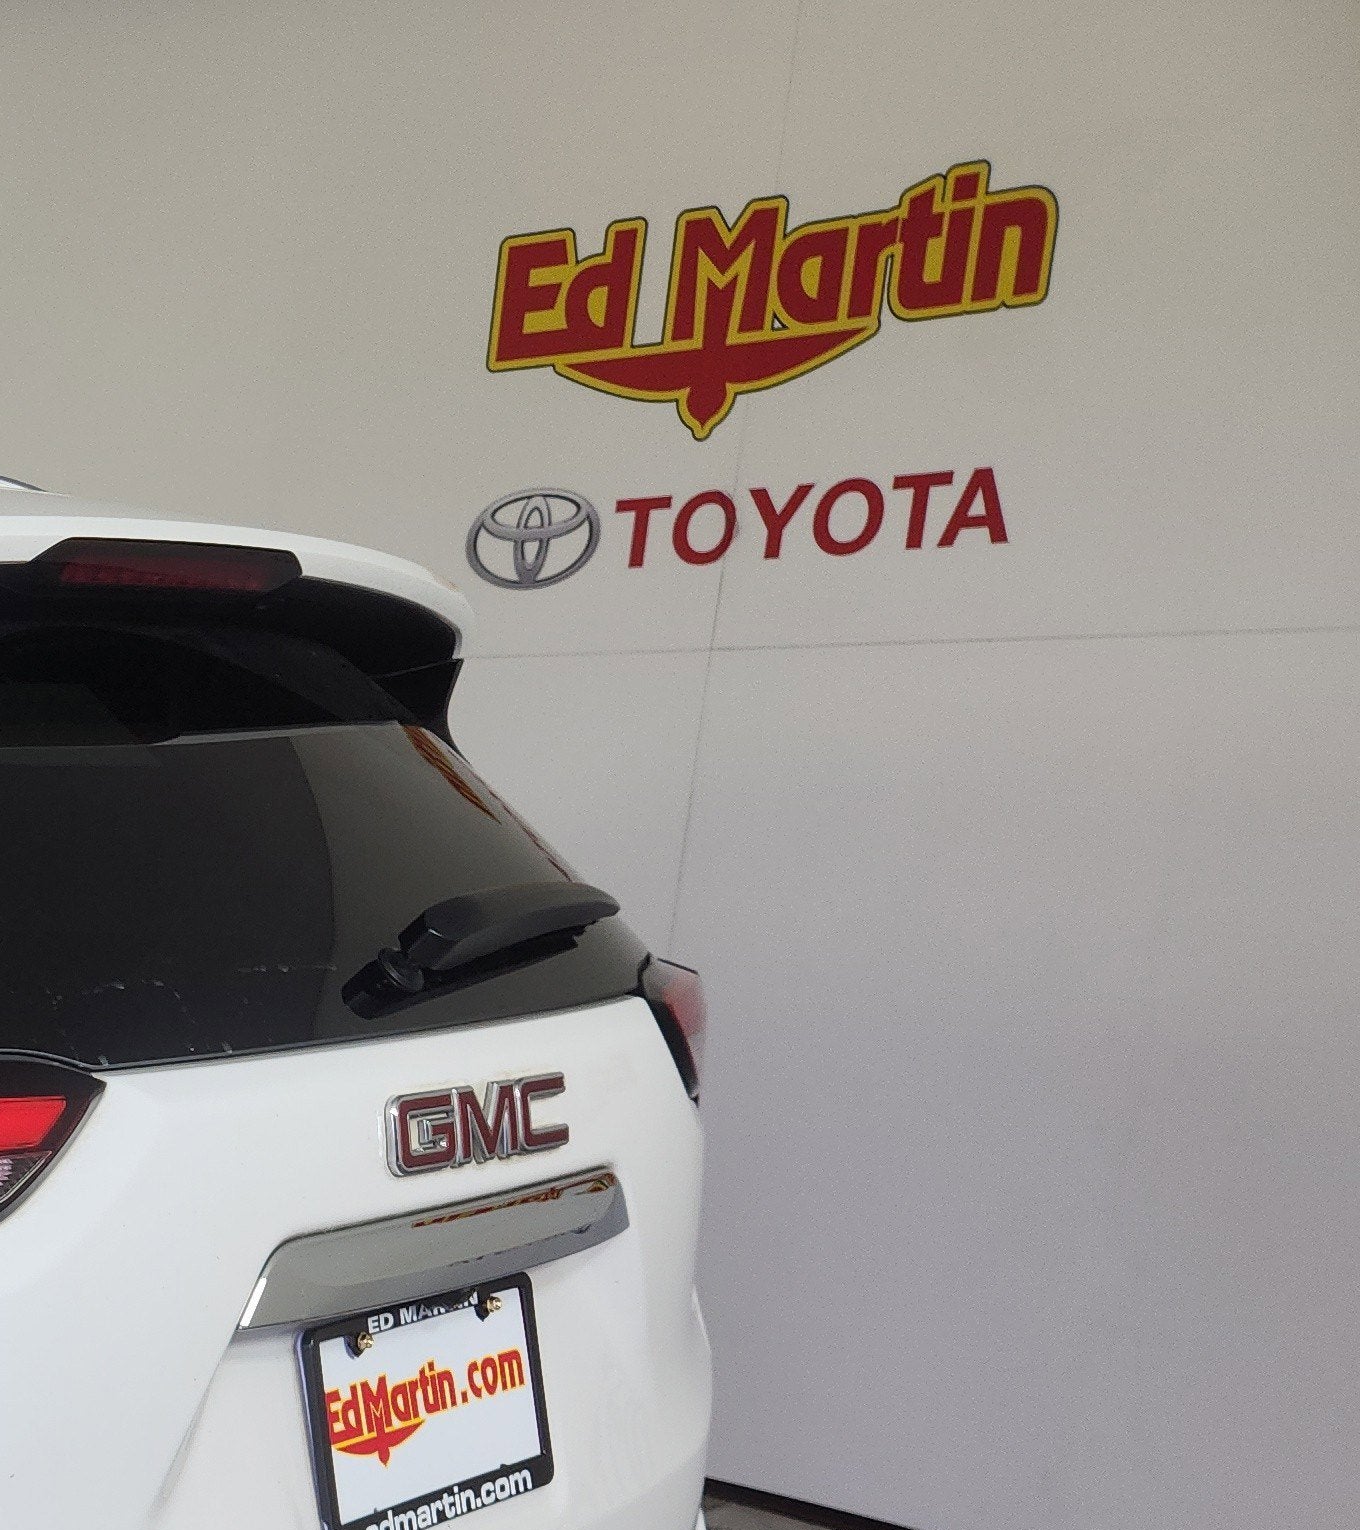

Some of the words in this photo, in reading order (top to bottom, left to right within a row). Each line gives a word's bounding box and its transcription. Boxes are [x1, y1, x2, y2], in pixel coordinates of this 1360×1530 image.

[492, 226, 642, 365] Ed
[670, 166, 1053, 345] Martin
[615, 467, 1009, 569] TOYOTA
[385, 1070, 571, 1178] GMC
[367, 1312, 395, 1335] ED
